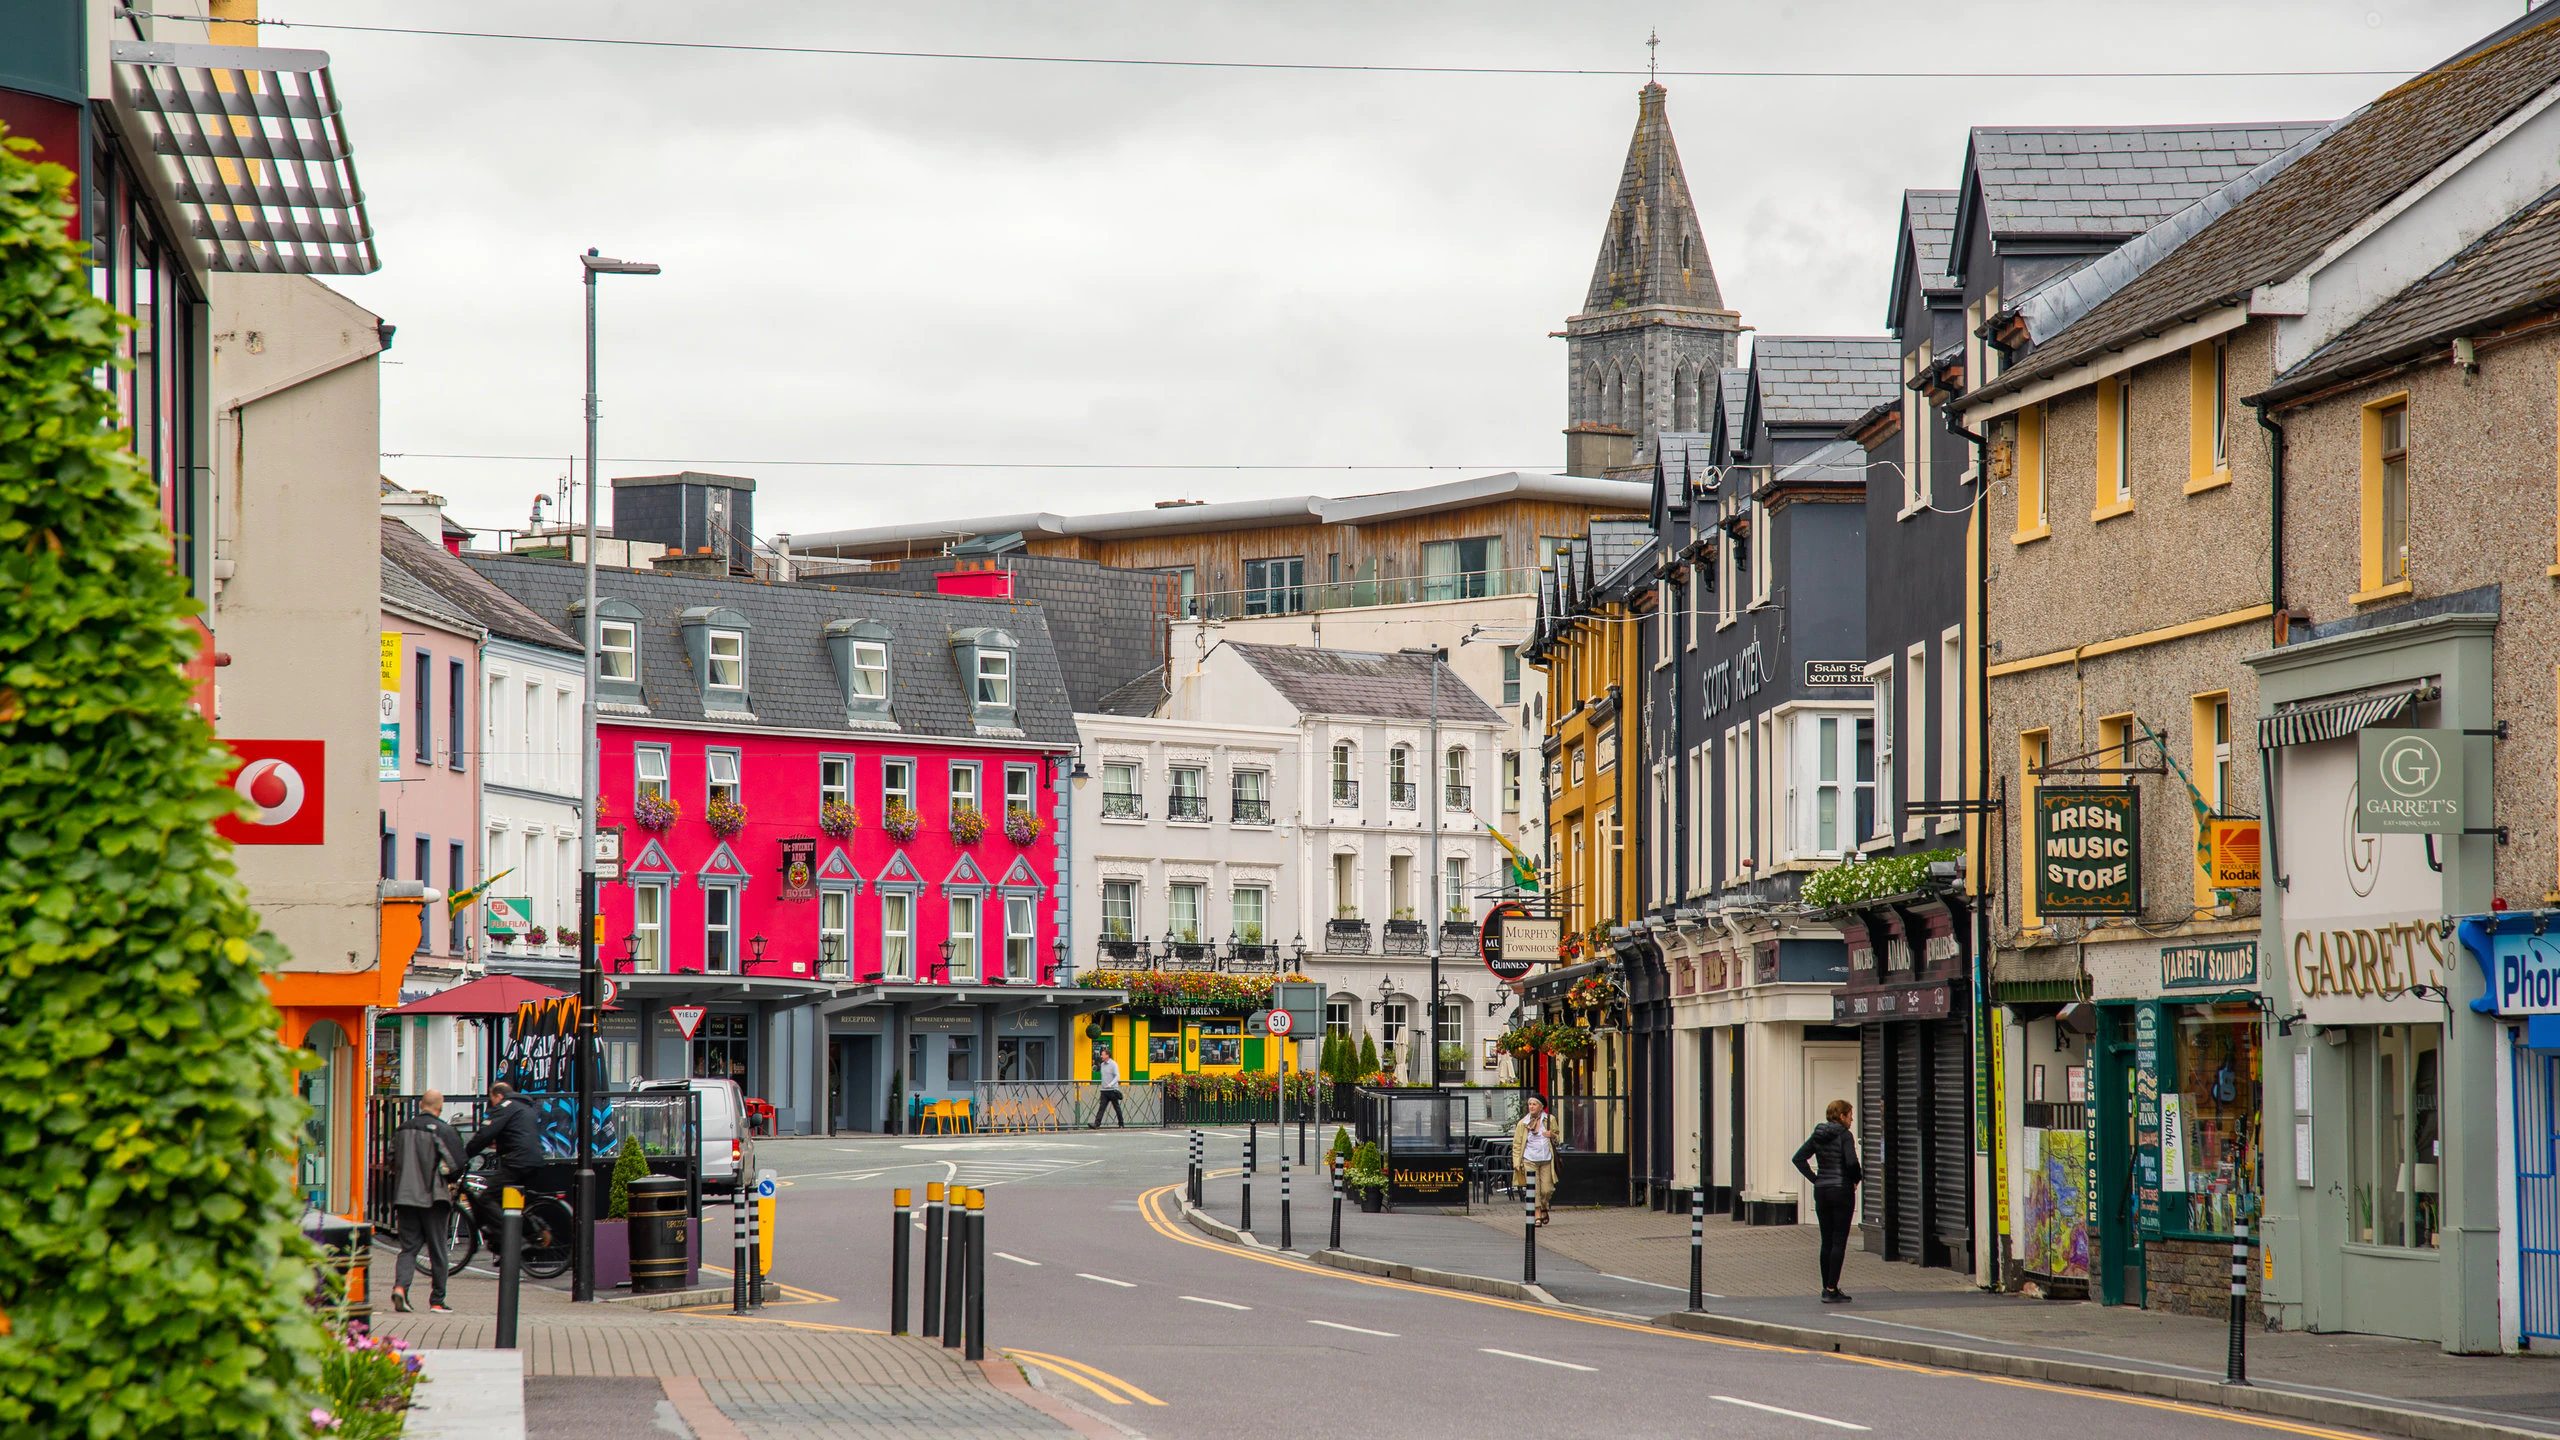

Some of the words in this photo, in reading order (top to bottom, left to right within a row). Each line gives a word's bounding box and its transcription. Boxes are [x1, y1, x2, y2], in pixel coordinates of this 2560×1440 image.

[1736, 642, 1759, 702] HOTEL
[1809, 674, 1848, 683] SCOTTS
[2366, 799, 2457, 818] GARRET'S
[2051, 806, 2122, 833] IRISH
[2047, 836, 2129, 859] MUSIC
[791, 852, 807, 862] ARMS
[2047, 863, 2128, 891] STORE
[2220, 869, 2260, 881] Kodak
[786, 888, 812, 898] HOTEL
[491, 920, 527, 928] FUJIFILM
[1505, 926, 1558, 940] MURPHY'S
[1505, 943, 1557, 953] TOWNHOUSE
[1887, 940, 1911, 971] ADAMS
[2448, 941, 2456, 972] 8
[1491, 960, 1529, 969] GUINNESS
[2162, 949, 2206, 985] VARIETY
[2208, 944, 2253, 982] SOUNDS
[2264, 952, 2272, 981] 8
[2294, 919, 2443, 999] GARRET'S
[841, 1015, 876, 1023] RECEPTION
[1162, 1007, 1188, 1016] JIMMY
[1190, 1006, 1220, 1016] BRIEN'S
[1273, 1015, 1286, 1027] 50
[2086, 1048, 2095, 1101] IRISH
[2138, 1111, 2158, 1126] PIANOS
[2087, 1108, 2096, 1162] MUSIC
[1394, 1168, 1464, 1183] MURPHY'S
[2089, 1168, 2097, 1222] STORE
